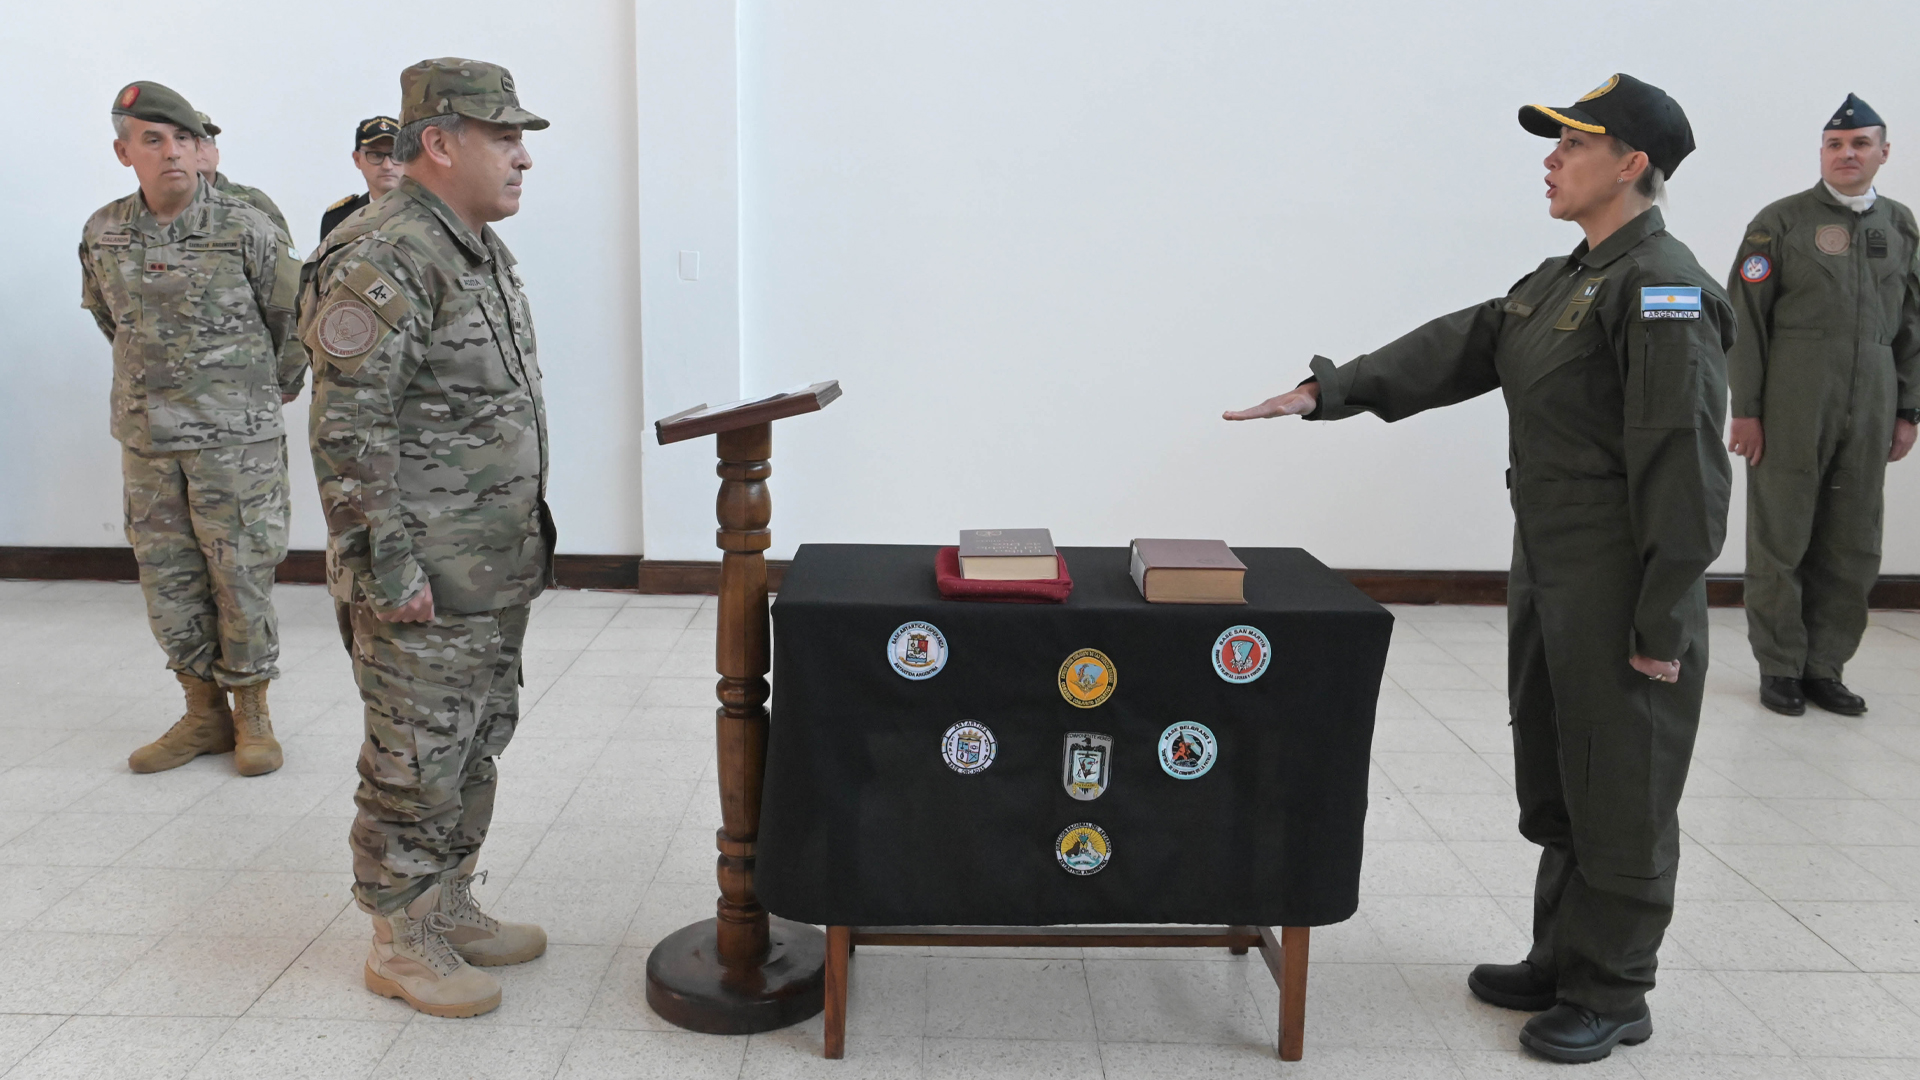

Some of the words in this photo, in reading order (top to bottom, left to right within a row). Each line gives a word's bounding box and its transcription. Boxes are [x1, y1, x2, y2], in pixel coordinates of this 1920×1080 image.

[368, 284, 387, 300] A+
[1218, 632, 1234, 646] BASE
[1247, 630, 1267, 648] MARTIN
[1164, 727, 1179, 741] BASE
